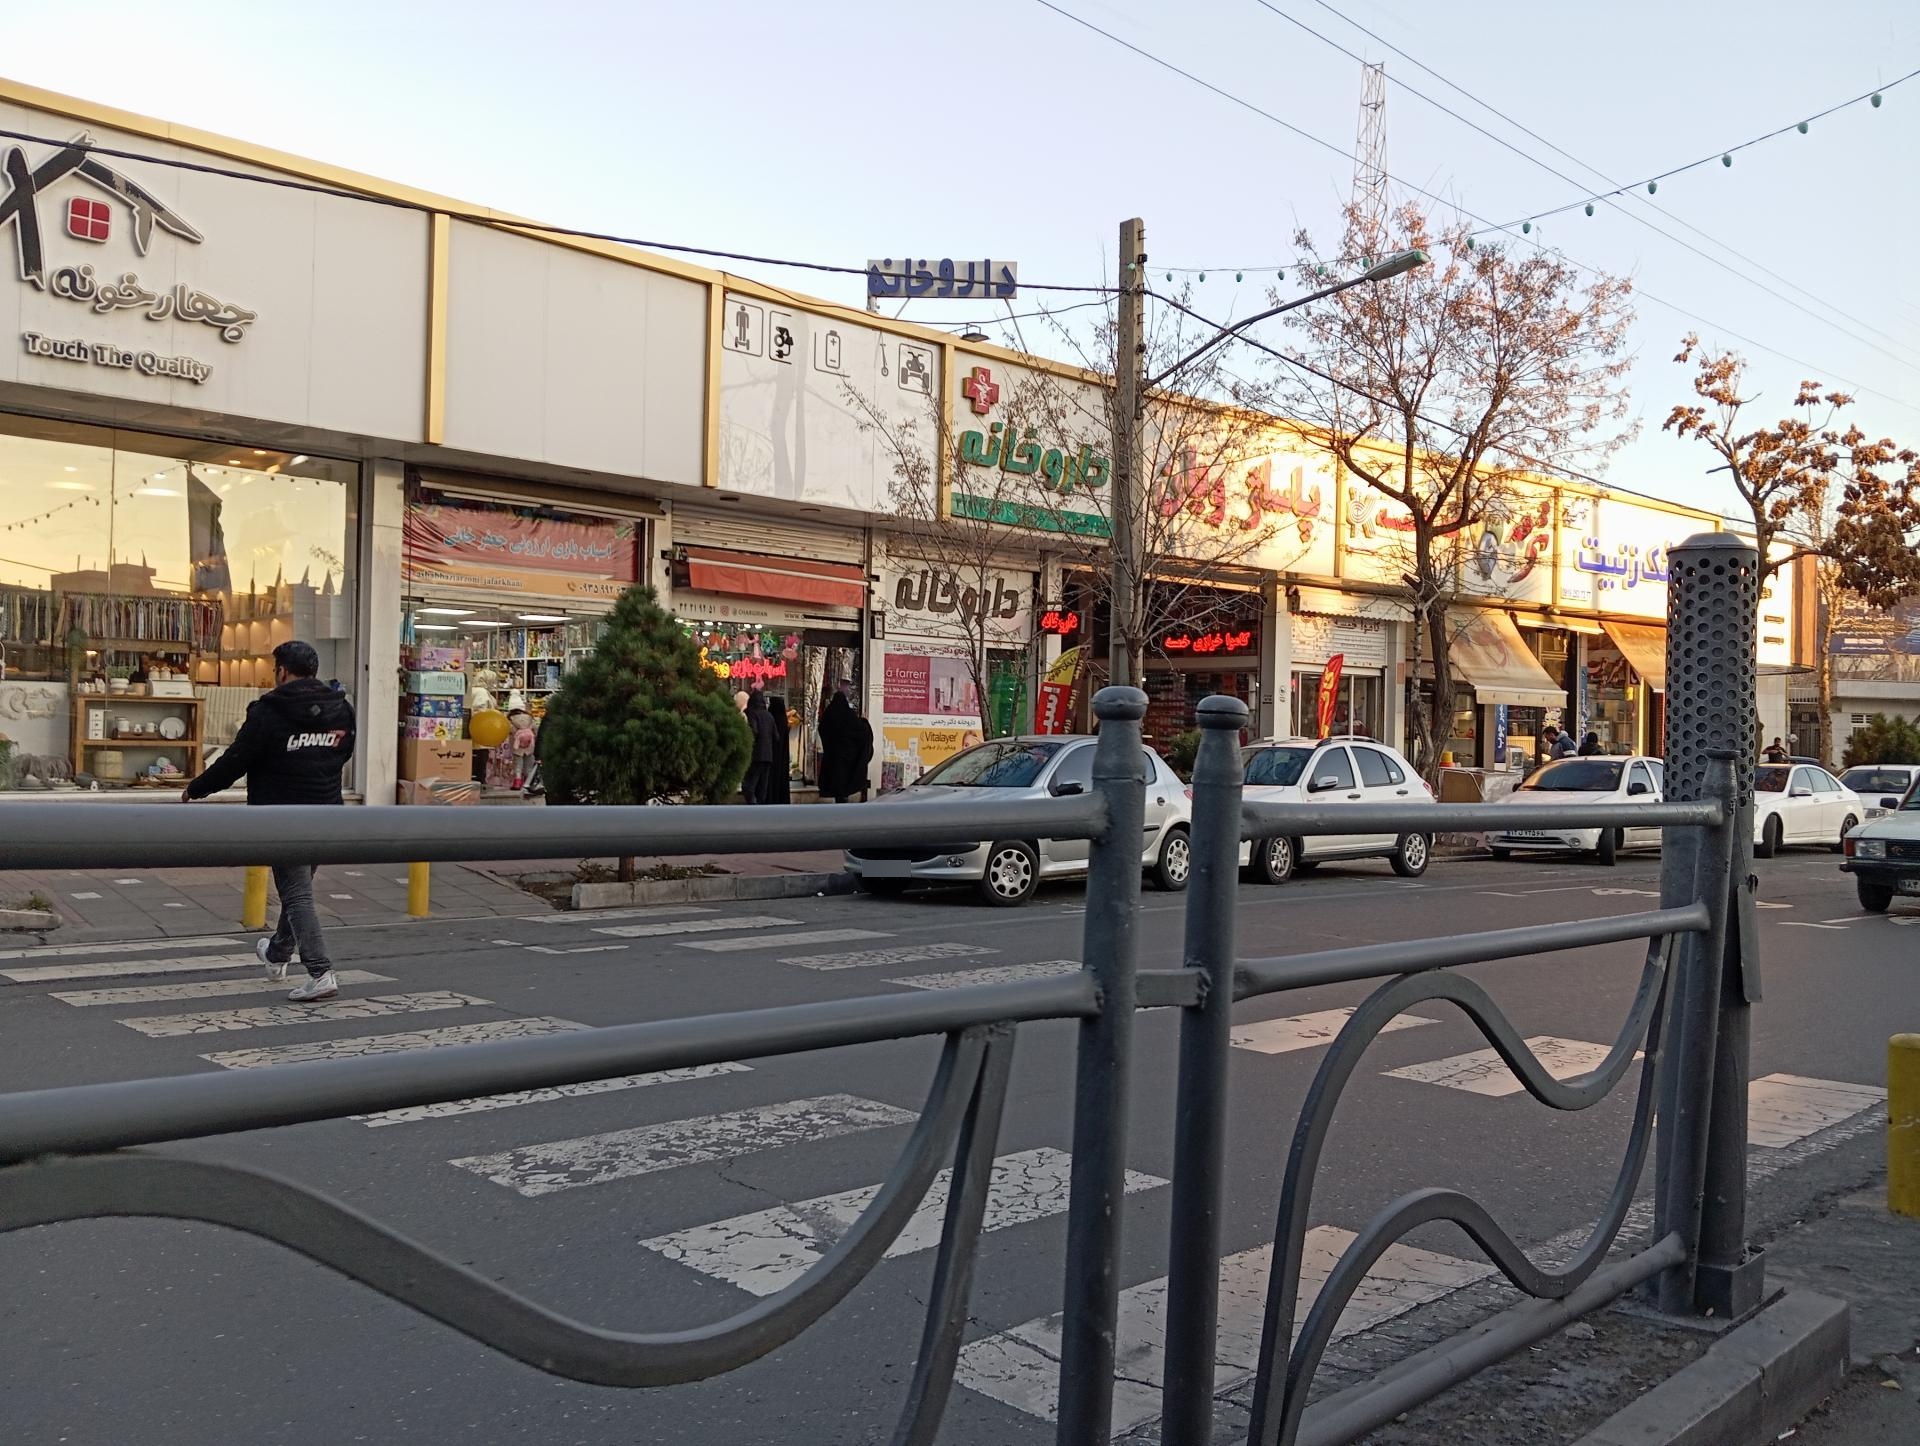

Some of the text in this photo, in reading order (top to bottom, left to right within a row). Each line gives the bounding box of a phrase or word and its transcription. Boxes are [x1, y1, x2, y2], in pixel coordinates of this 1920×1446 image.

[51, 263, 258, 343] چهارخونه
[867, 258, 1016, 297] داروخانه
[24, 331, 213, 384] Touch The Quality
[959, 421, 1109, 496] داروخانه
[895, 569, 1019, 627] داروخانه
[1165, 631, 1251, 652] کاموا خرازی خمسه
[925, 731, 958, 744] Vitalayer
